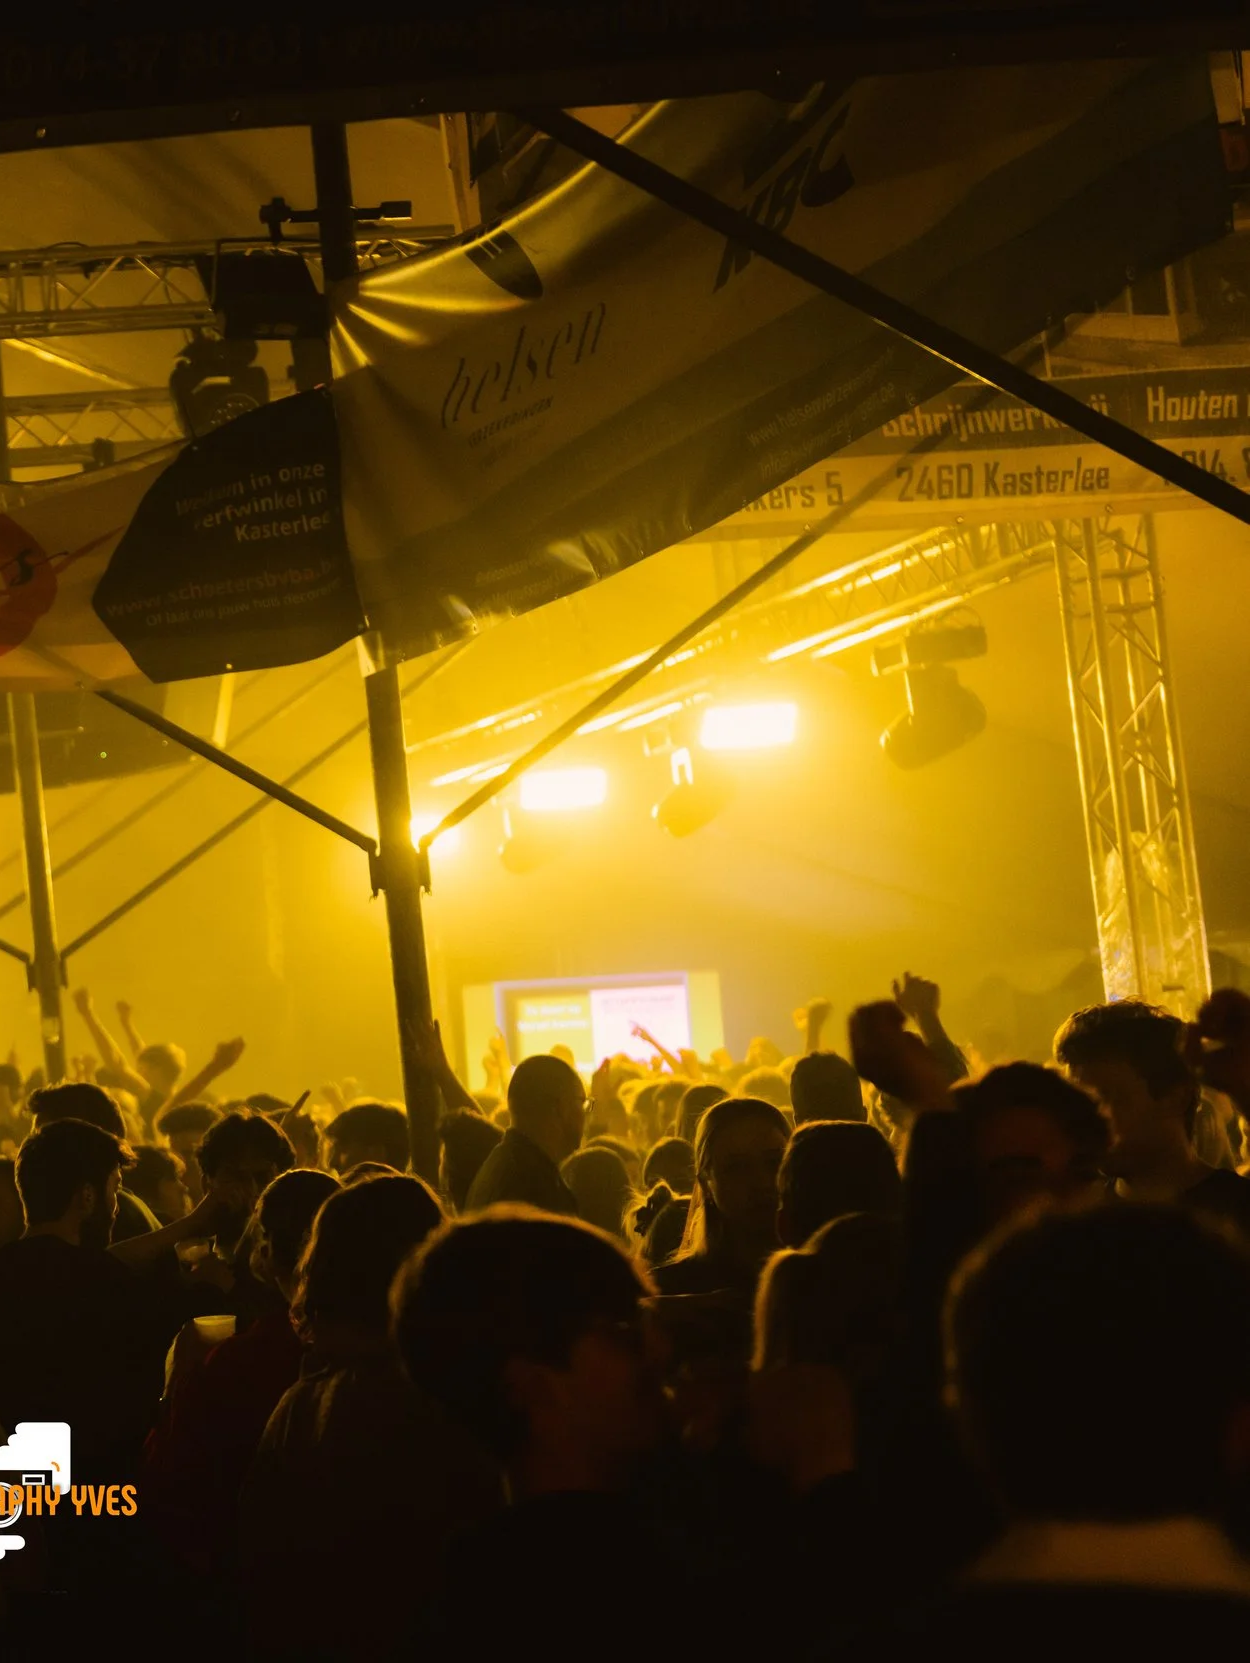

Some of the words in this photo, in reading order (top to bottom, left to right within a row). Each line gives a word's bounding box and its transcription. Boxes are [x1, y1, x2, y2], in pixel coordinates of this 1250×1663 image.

[440, 301, 607, 430] helsen
[1146, 385, 1239, 424] Houten
[250, 472, 273, 491] in
[278, 462, 326, 484] onze
[307, 485, 329, 506] in
[824, 470, 844, 507] 5
[896, 462, 974, 503] 2460
[983, 456, 1111, 498] Kasterlee
